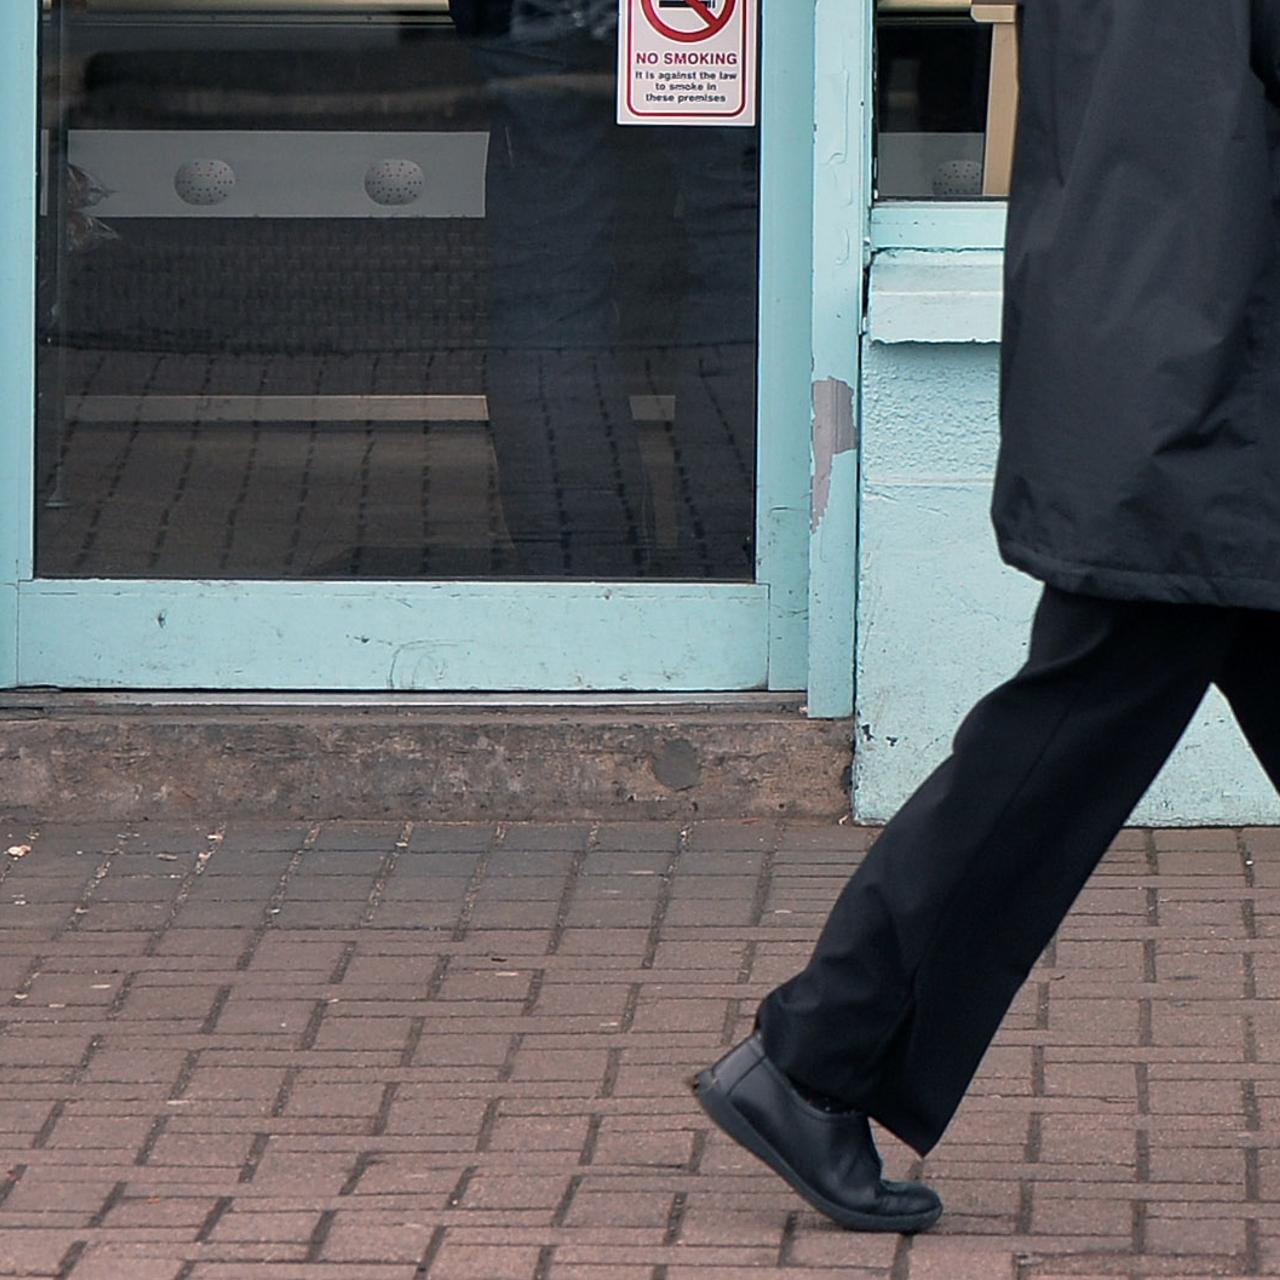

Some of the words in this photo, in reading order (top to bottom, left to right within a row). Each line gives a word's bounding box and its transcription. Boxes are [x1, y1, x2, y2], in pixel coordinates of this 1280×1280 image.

[636, 52, 659, 65] NO
[664, 52, 738, 65] SMOKING
[636, 71, 643, 80] It
[645, 71, 654, 80] is
[657, 71, 697, 82] against
[699, 71, 716, 80] the
[719, 71, 738, 80] law
[655, 83, 666, 92] to
[669, 82, 704, 92] smoke
[707, 82, 717, 92] in
[646, 93, 674, 103] these
[677, 93, 726, 105] premises
